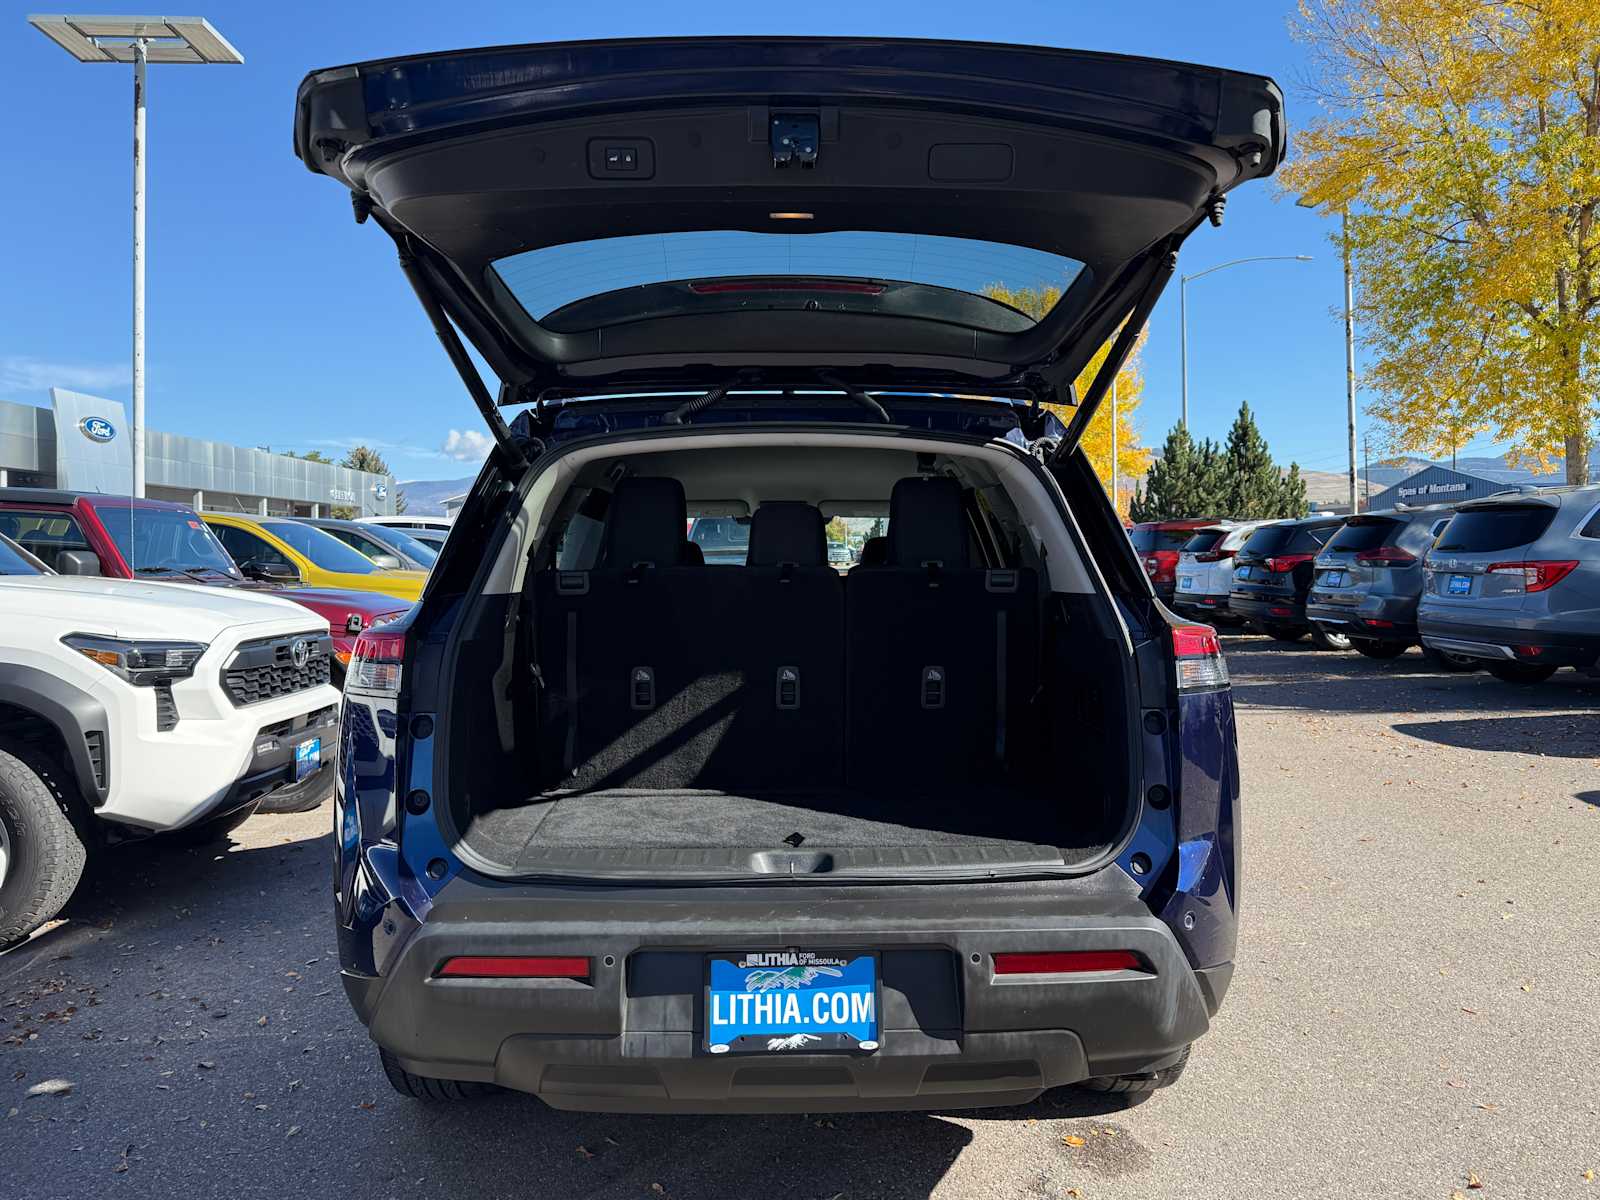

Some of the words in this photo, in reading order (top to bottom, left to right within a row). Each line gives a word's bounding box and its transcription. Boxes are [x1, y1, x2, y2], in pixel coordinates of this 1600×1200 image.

[91, 420, 111, 437] Ford
[1398, 487, 1417, 498] Spas
[1418, 485, 1428, 495] of
[1428, 483, 1467, 494] Montana
[759, 952, 799, 966] LITHIA
[808, 958, 841, 966] MISSOULA
[712, 991, 875, 1026] LITHIA.COM
